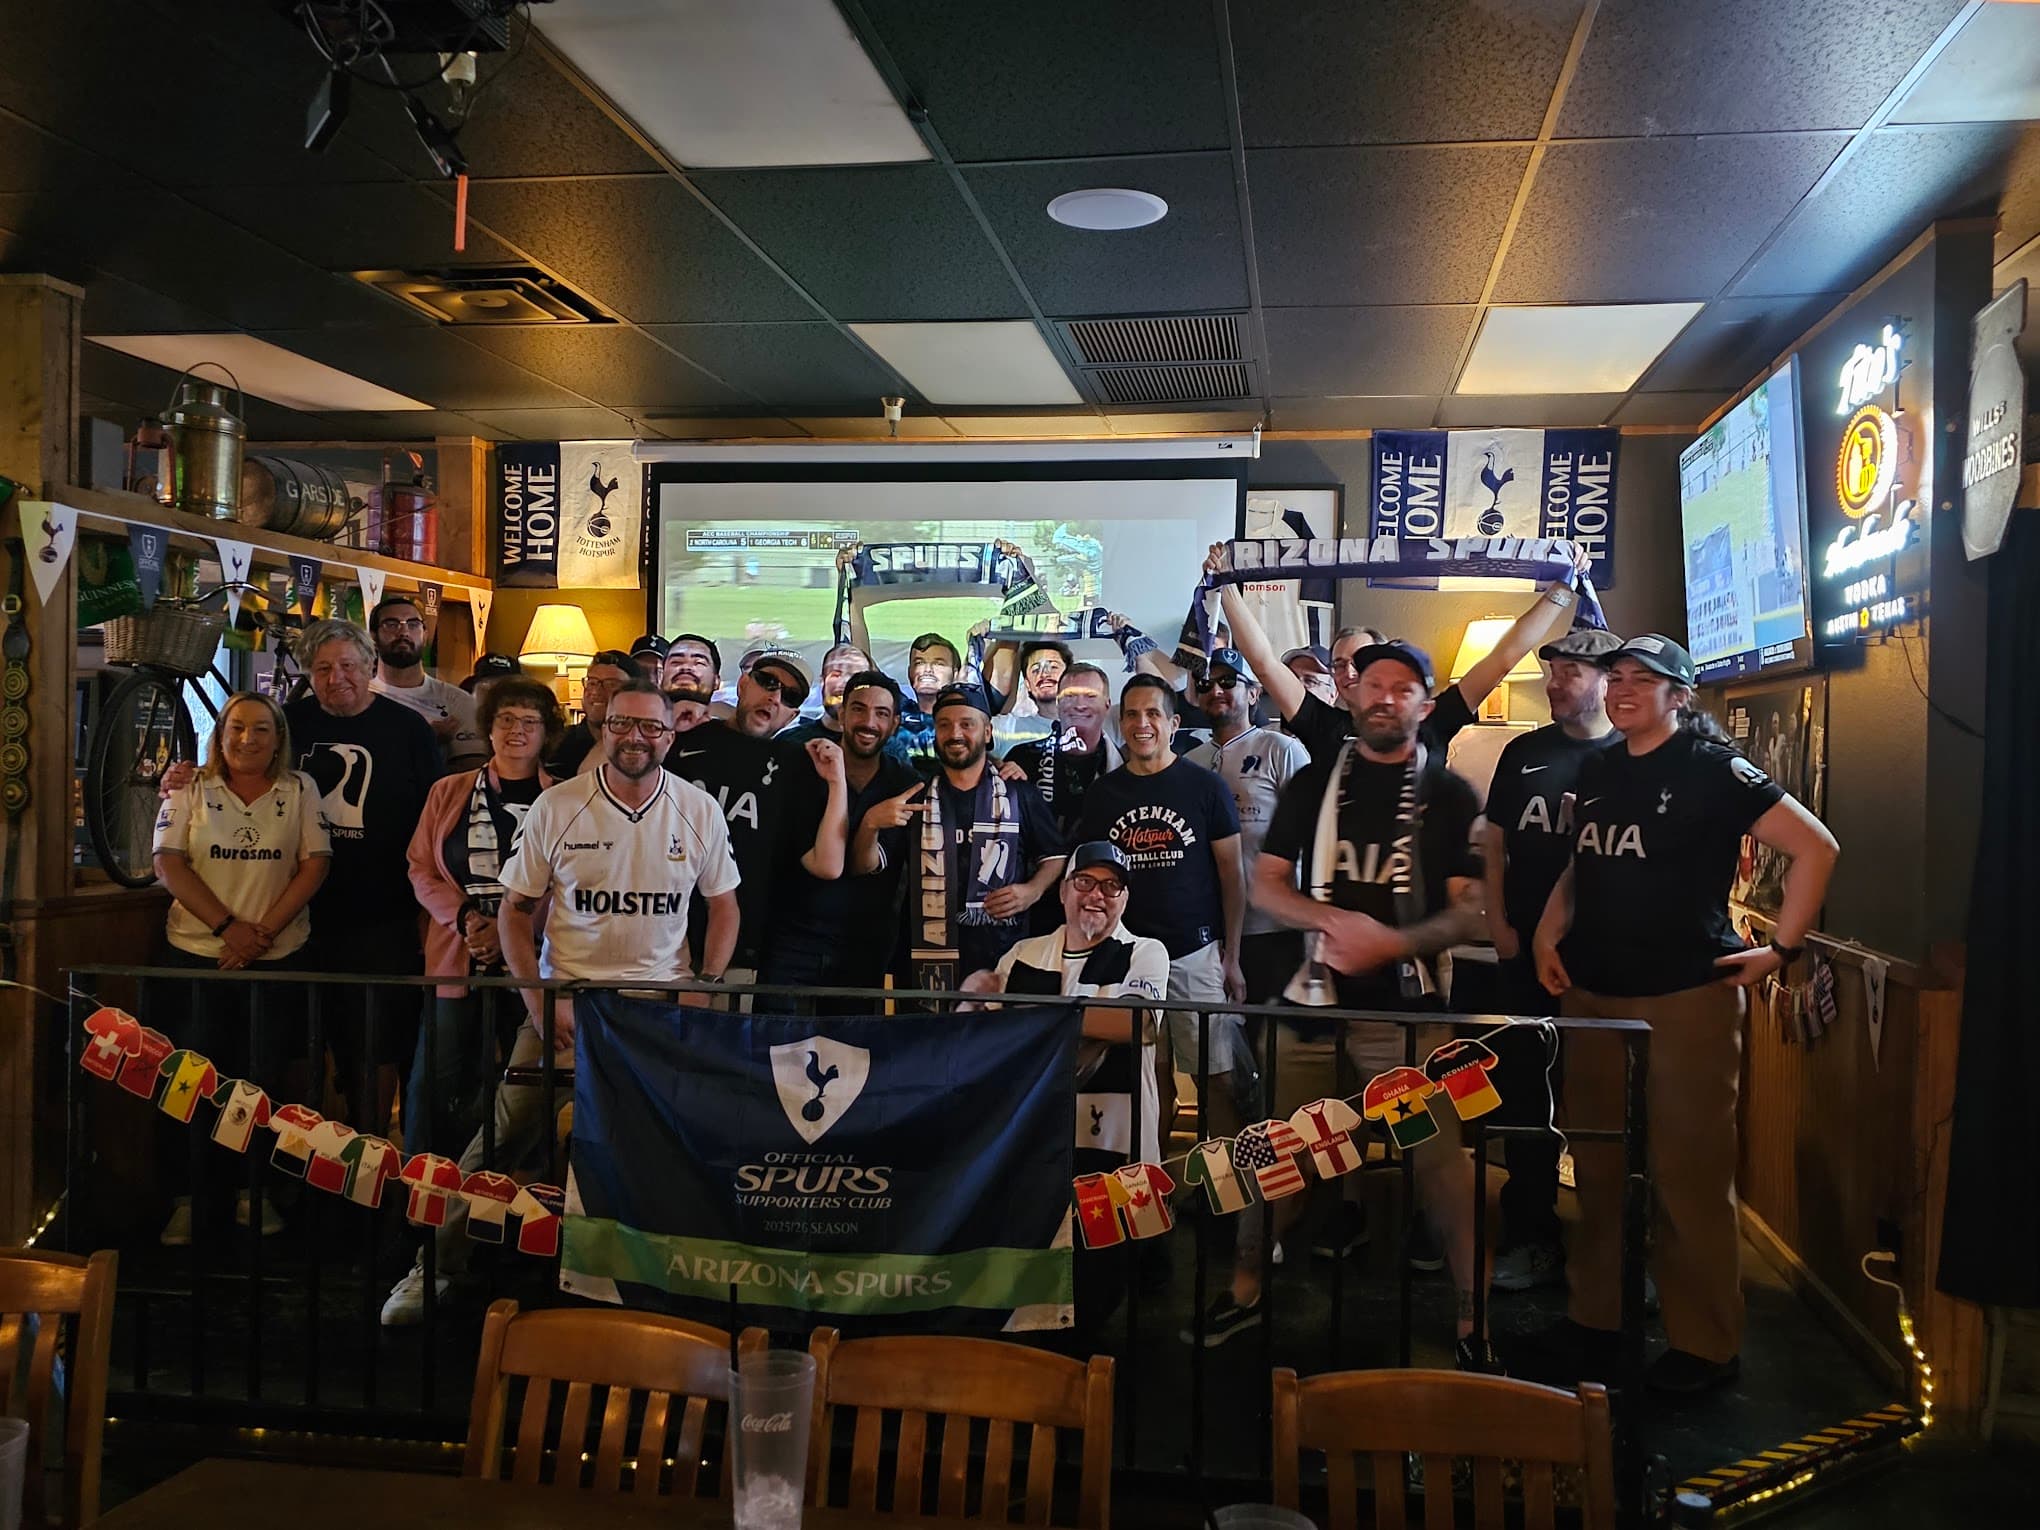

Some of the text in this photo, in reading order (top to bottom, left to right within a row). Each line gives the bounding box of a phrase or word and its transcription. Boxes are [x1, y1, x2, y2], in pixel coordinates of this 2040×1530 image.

[1962, 433, 2016, 489] WOODBINES
[286, 480, 345, 507] GARSIDE
[1378, 452, 1403, 539] ELCOME
[1546, 452, 1572, 539] ELCOME
[504, 463, 522, 565] WELCOME
[527, 464, 555, 561] HOME
[1574, 451, 1612, 560] HOME
[576, 535, 621, 548] TOTTENHAM
[579, 547, 616, 558] HOTSPUR
[740, 538, 747, 546] 5
[800, 538, 808, 546] 6
[1426, 537, 1574, 560] SPURS
[870, 545, 980, 573] SPURS
[1243, 583, 1286, 592] omson
[1844, 573, 1887, 606] VODKA
[990, 612, 1078, 633] PURS
[1826, 596, 1906, 636] AUSTIN TEXAS
[692, 779, 759, 831] IA
[1517, 793, 1577, 836] AI
[331, 827, 365, 840] SPURS
[1108, 805, 1197, 847] OTTENHAM
[563, 841, 600, 851] hummel
[1121, 827, 1176, 851] Hotspur
[1577, 821, 1647, 859] AIA
[210, 844, 281, 860] Aurasma
[1159, 850, 1184, 859] CLUB
[575, 889, 683, 916] HOLSTEN
[1129, 979, 1160, 1000] cinc
[1441, 1058, 1480, 1080] GERMANY
[1382, 1084, 1411, 1101] GHANA
[1315, 1134, 1346, 1150] ENGLAND
[764, 1151, 858, 1164] OFFICIAL
[734, 1164, 893, 1195] SPURS
[1125, 1179, 1148, 1189] CANADA
[736, 1193, 893, 1209] SUPPORTERS' CLUB
[763, 1220, 859, 1235] 2025/26 SEASON
[666, 1253, 953, 1299] ARIZONA SPURS
